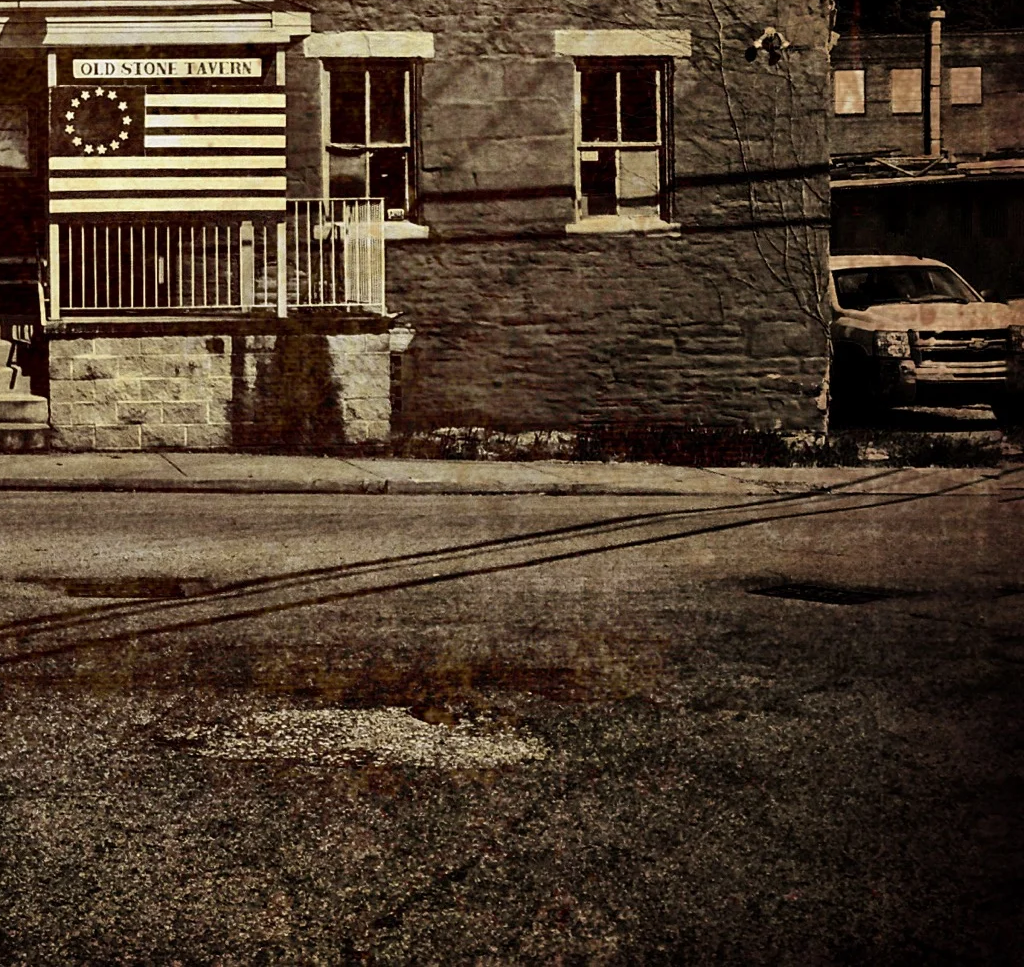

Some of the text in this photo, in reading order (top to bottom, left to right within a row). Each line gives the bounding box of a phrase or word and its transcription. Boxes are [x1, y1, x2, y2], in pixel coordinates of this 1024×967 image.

[80, 61, 253, 76] OLD STONE TAVERN
